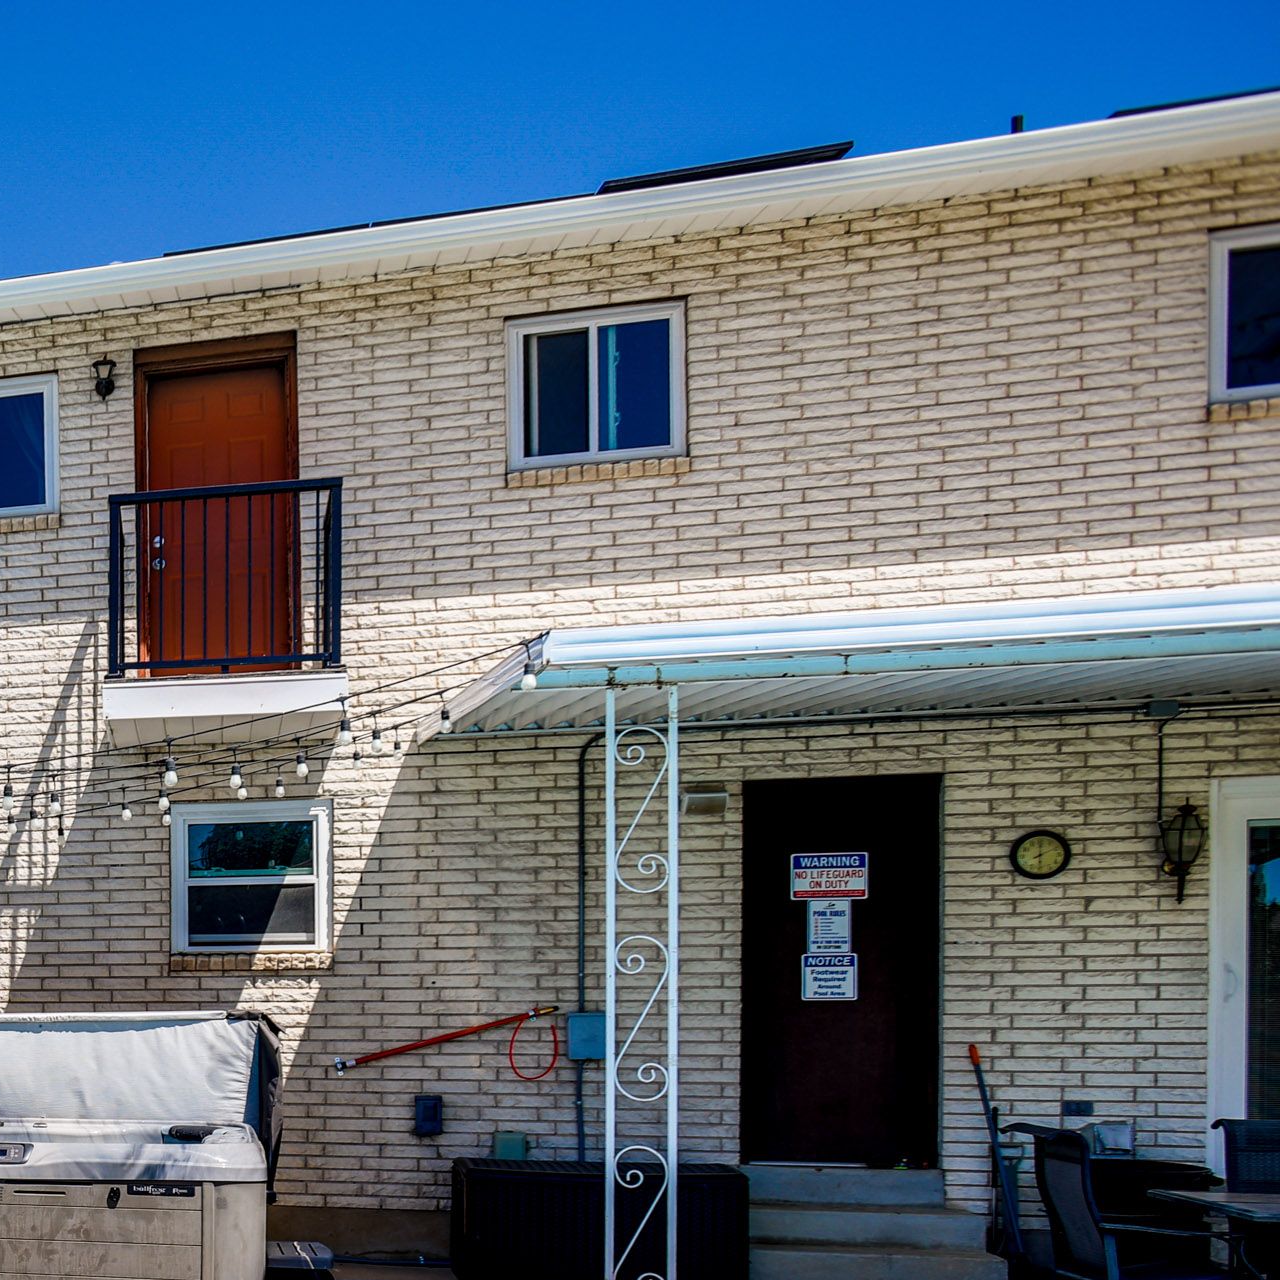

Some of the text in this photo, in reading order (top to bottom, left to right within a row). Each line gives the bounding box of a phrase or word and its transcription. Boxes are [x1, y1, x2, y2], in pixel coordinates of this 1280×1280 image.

[800, 856, 860, 867] WARNING
[794, 869, 864, 879] NO LIFEGUARD
[808, 880, 849, 889] ON DUTY
[807, 957, 852, 966] NOTICE
